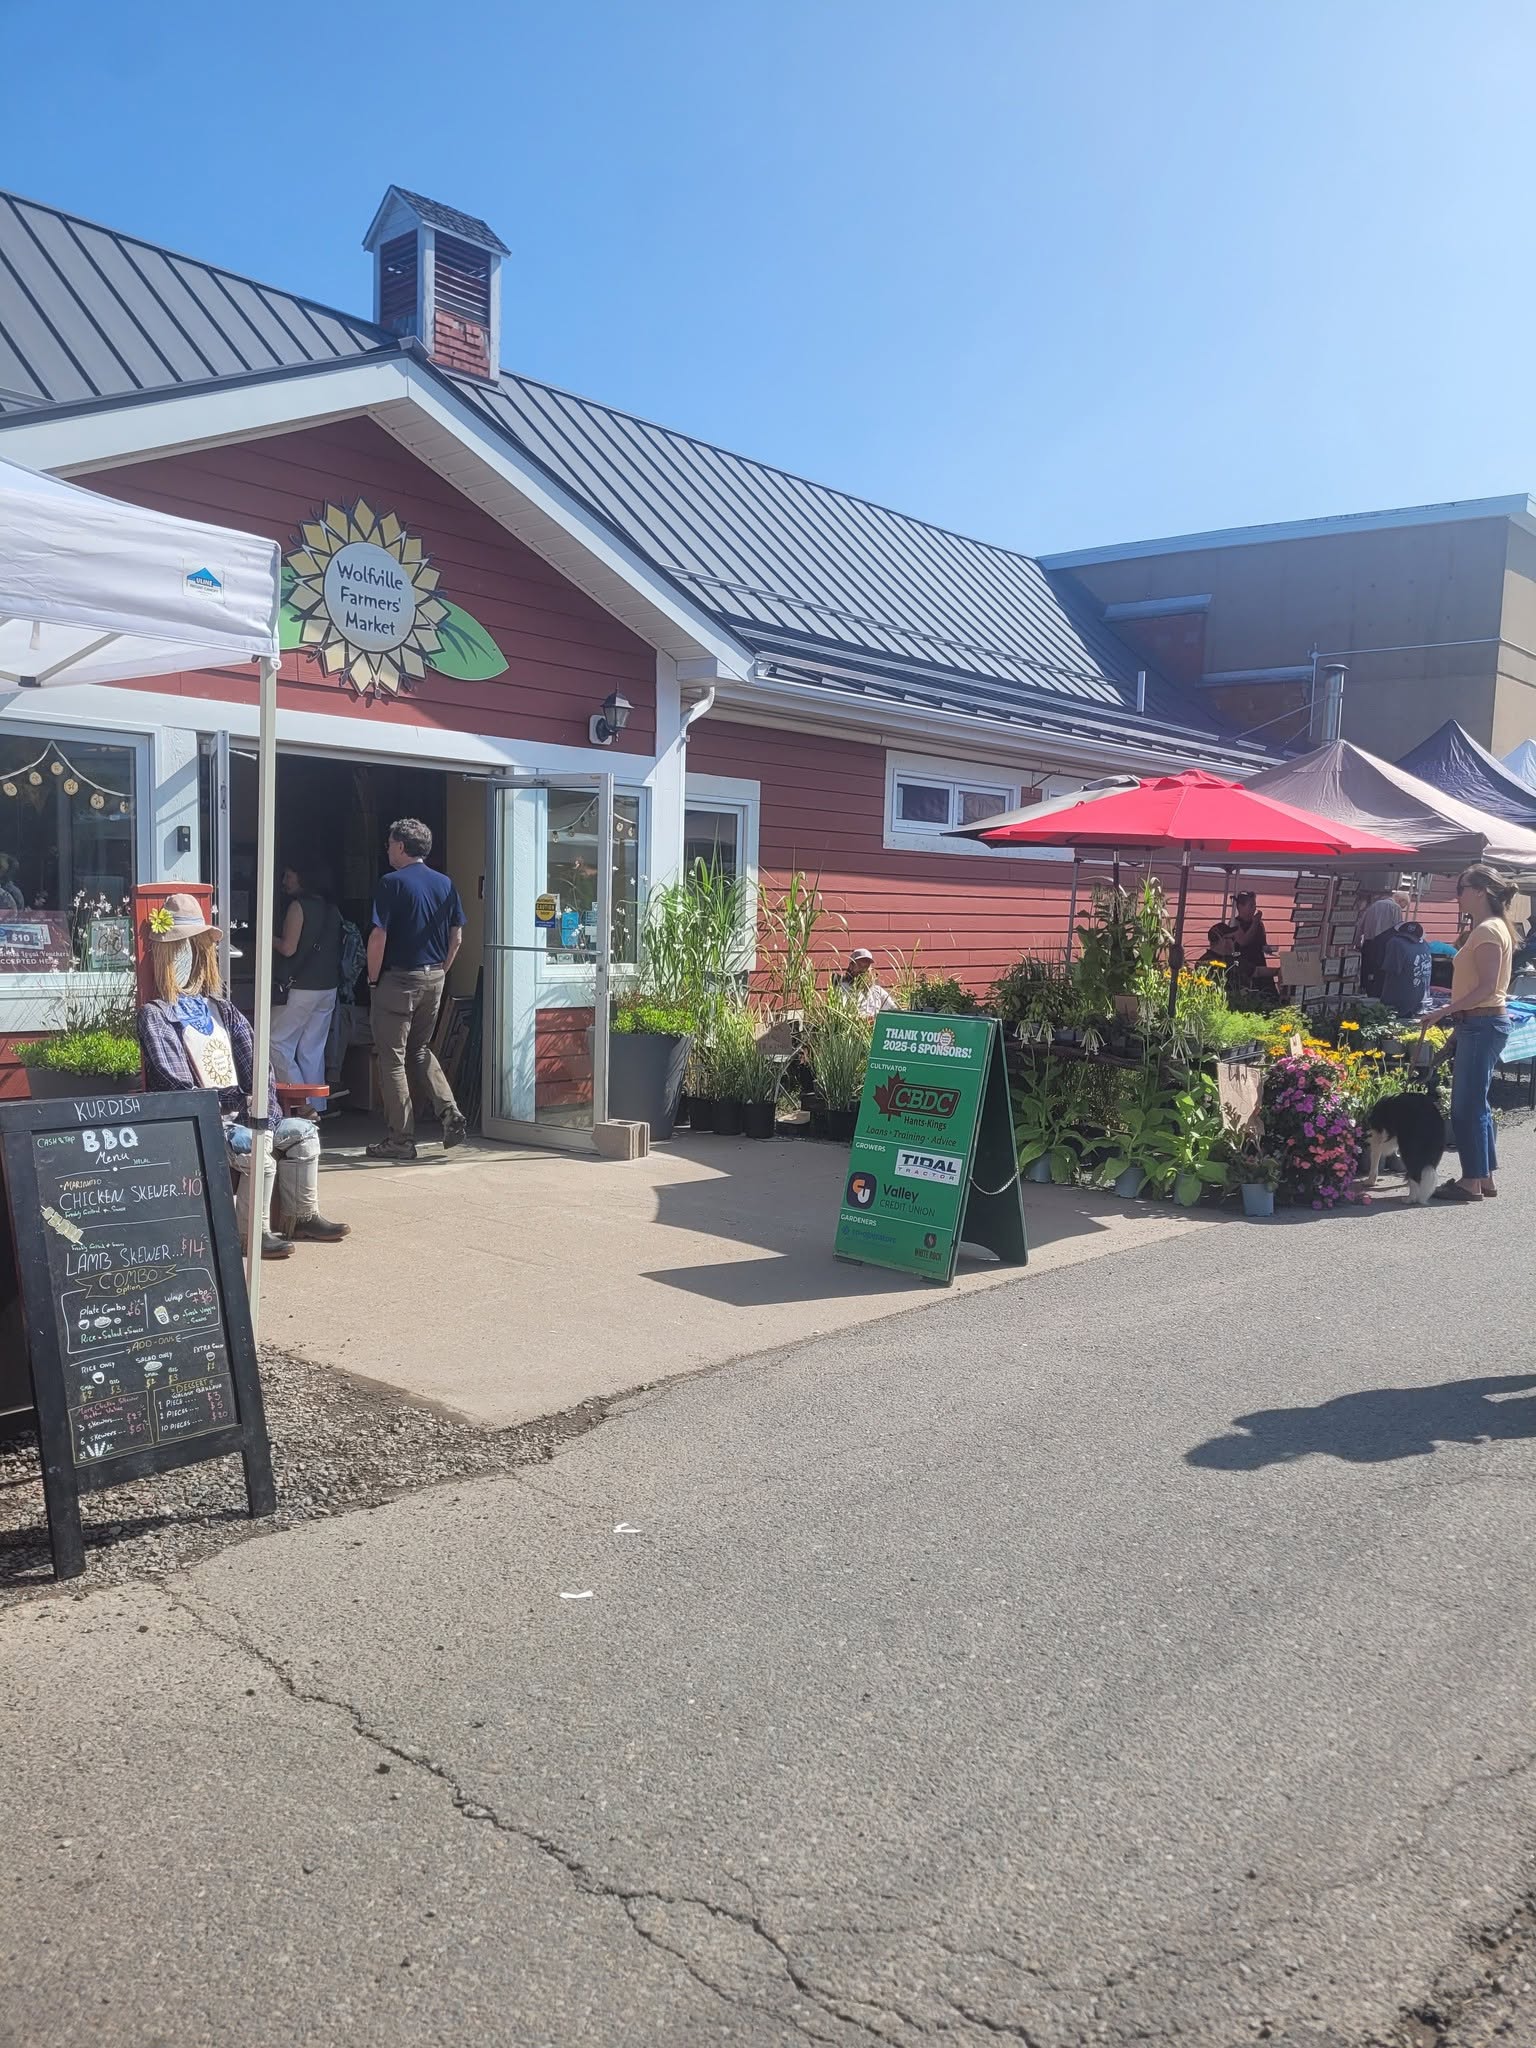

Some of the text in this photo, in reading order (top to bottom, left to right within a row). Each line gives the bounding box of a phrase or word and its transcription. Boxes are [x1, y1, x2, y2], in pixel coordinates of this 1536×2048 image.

[337, 560, 404, 590] Wolfville
[340, 586, 401, 613] Farmers'
[345, 611, 396, 637] Market
[11, 933, 30, 942] $10
[886, 1028, 919, 1041] THANK
[920, 1031, 941, 1043] YOU
[883, 1040, 972, 1058] 2025-6 SPONSORS!
[870, 1062, 907, 1072] CULTIVATOR
[895, 1087, 954, 1112] CBDC
[74, 1098, 141, 1122] KURDISH
[904, 1116, 947, 1132] Hants-Kings
[37, 1137, 57, 1148] CASH
[82, 1126, 139, 1152] BBQ
[866, 1125, 957, 1147] Loans Training Advice
[855, 1142, 886, 1152] GROWERS
[96, 1151, 130, 1164] Menu
[902, 1154, 956, 1173] TIDAL
[898, 1167, 954, 1181] TRACTOR
[59, 1187, 124, 1210] CHICKEN
[883, 1184, 919, 1203] Valley
[880, 1199, 936, 1217] CREDIT UNION
[840, 1213, 877, 1226] GARDENERS
[66, 1251, 112, 1276] LAMB
[181, 1238, 206, 1258] $14
[98, 1269, 159, 1289] COMBO
[185, 1287, 208, 1299] Combo
[101, 1303, 127, 1314] Combo
[80, 1333, 97, 1344] Rice
[81, 1365, 97, 1374] RICE
[175, 1379, 208, 1393] DESSERT
[207, 1391, 221, 1401] $3
[80, 1437, 86, 1445] 6
